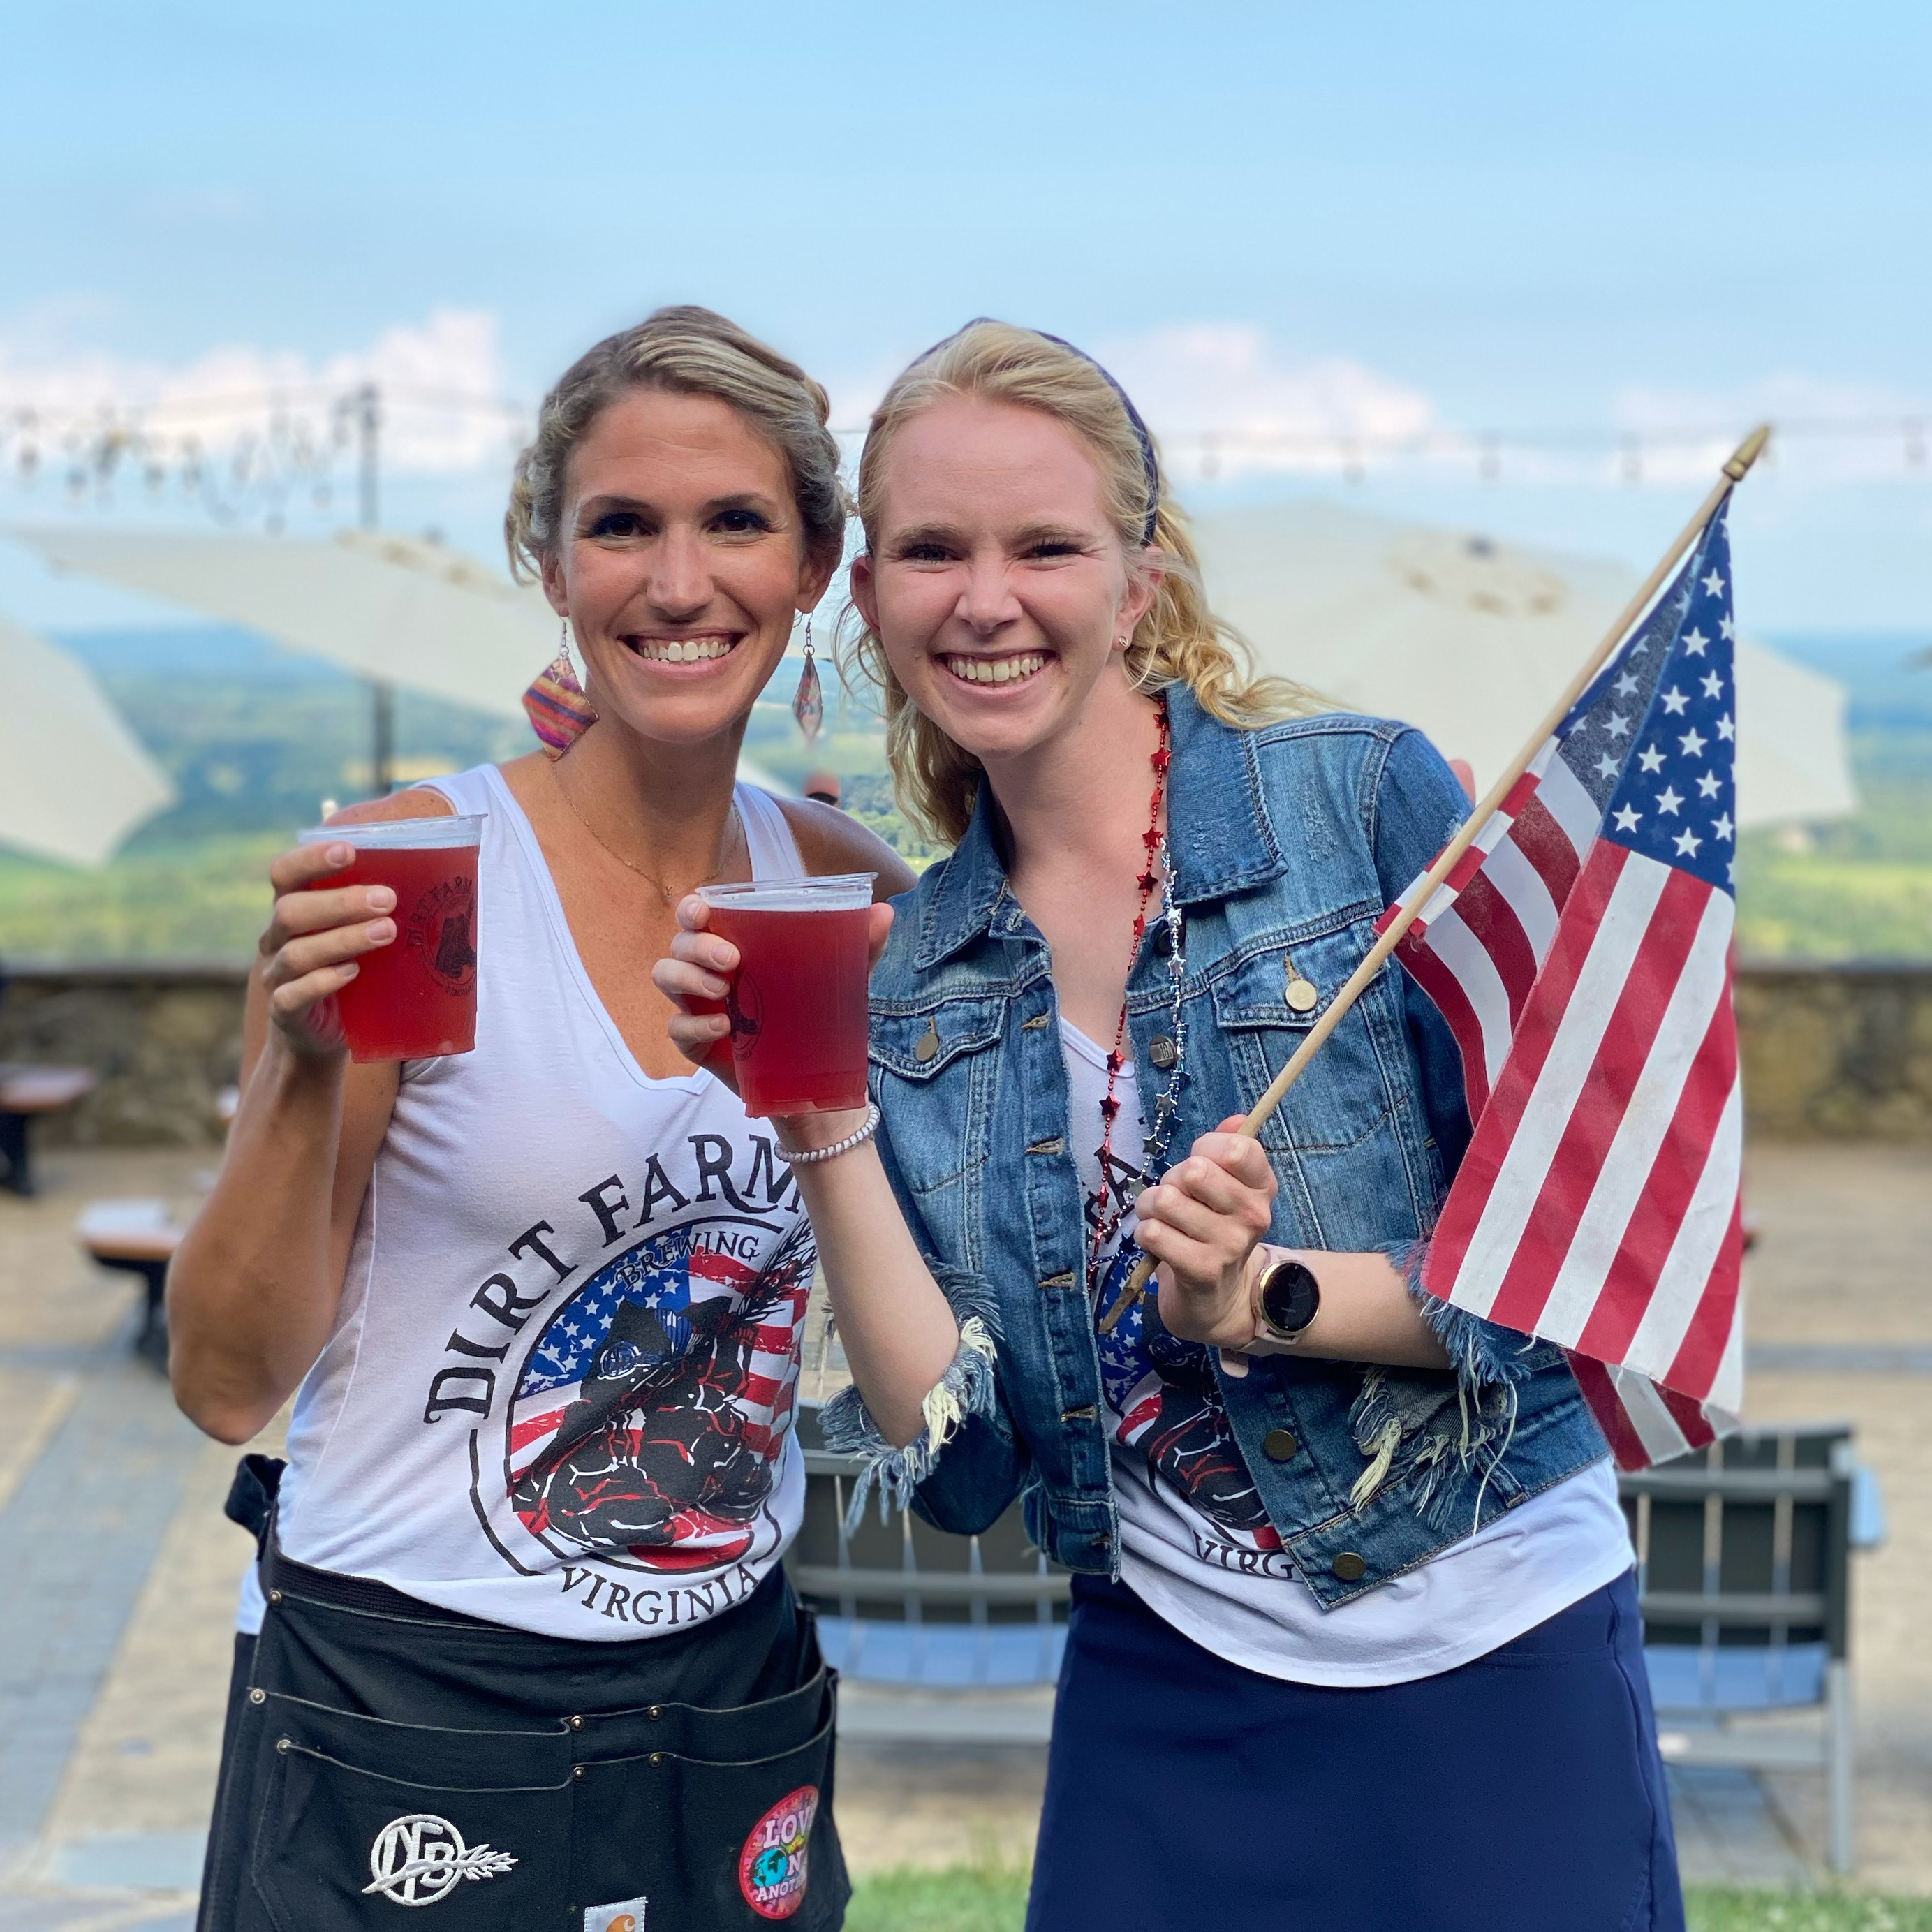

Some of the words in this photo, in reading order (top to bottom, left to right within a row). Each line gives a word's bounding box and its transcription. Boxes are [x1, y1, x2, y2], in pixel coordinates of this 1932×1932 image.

[423, 1220, 578, 1424] DIRT
[578, 1134, 799, 1247] FARM
[614, 1230, 760, 1290] BREWING
[561, 1561, 760, 1625] VIRGINIA
[763, 1804, 813, 1849] LOV
